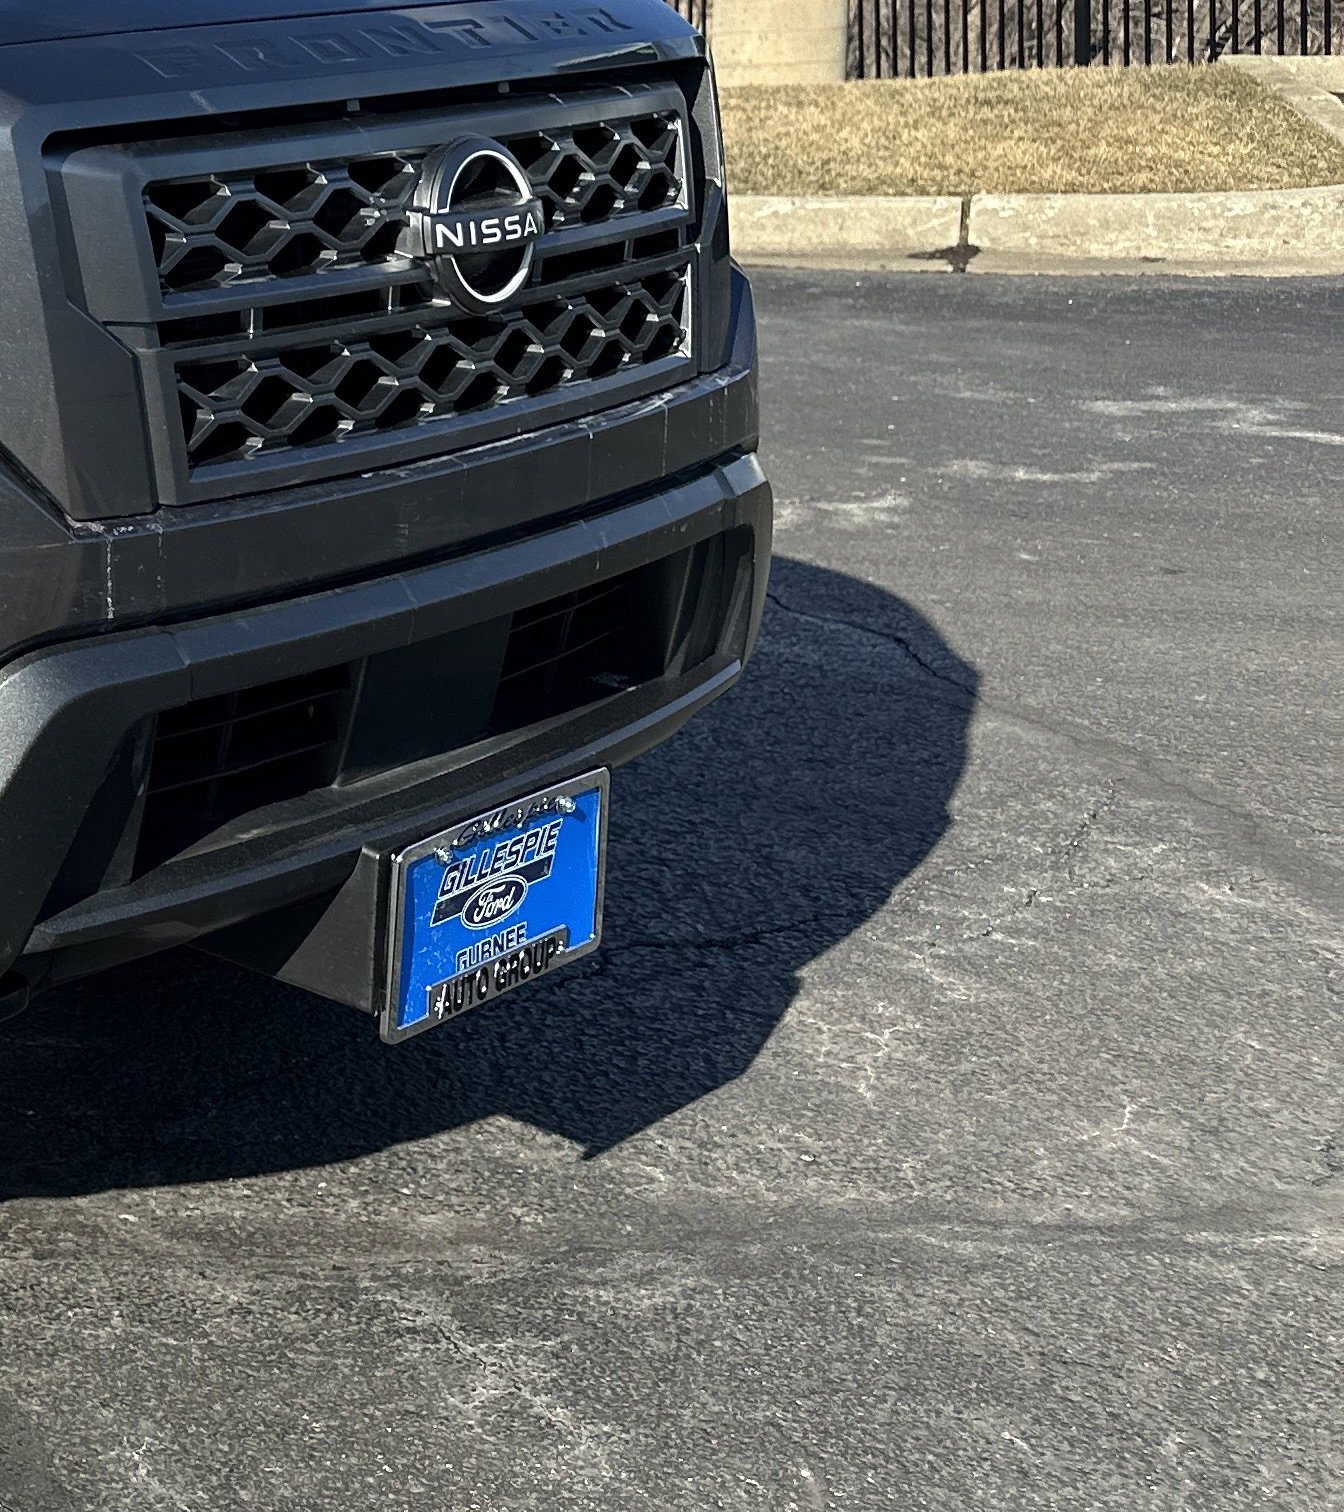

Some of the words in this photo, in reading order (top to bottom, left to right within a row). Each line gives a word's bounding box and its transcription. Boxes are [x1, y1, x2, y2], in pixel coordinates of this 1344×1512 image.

[133, 6, 635, 80] FRONTIER
[434, 212, 539, 248] NISSA
[437, 817, 564, 899] GILLESPIE
[473, 883, 516, 923] Ford
[455, 920, 528, 972] GURNEE
[433, 967, 489, 1020] AUTO
[493, 936, 557, 991] GROUP
